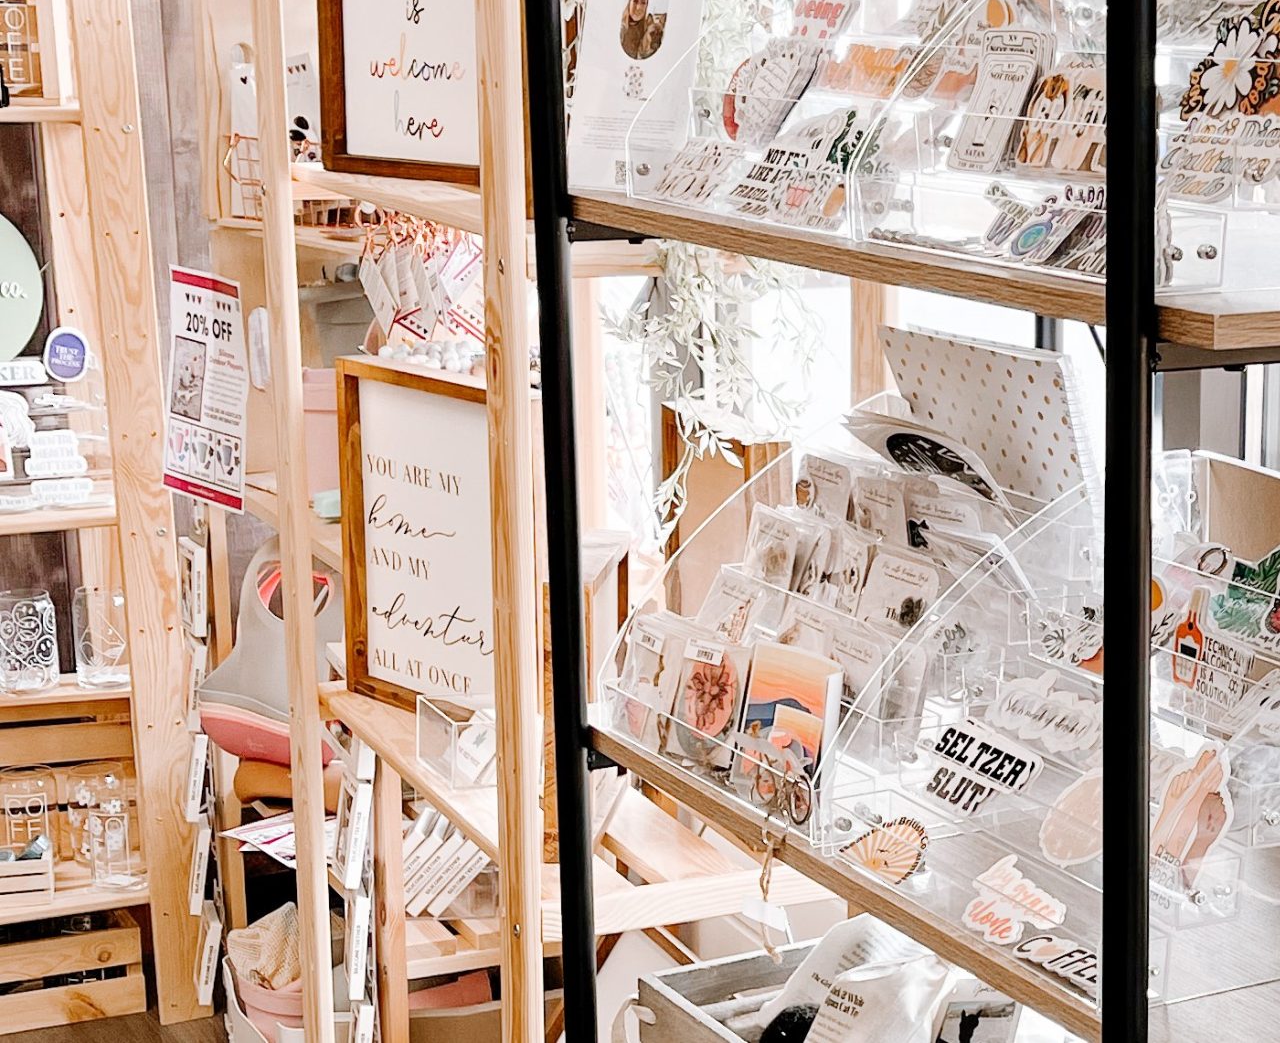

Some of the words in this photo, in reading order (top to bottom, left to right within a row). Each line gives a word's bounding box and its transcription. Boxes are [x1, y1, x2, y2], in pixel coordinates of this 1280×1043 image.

[370, 33, 465, 81] welcome
[394, 90, 444, 140] here
[186, 312, 208, 336] 20%
[212, 318, 232, 342] OFF
[367, 454, 397, 480] YOU
[403, 465, 432, 489] ARE
[439, 472, 461, 496] MY
[368, 494, 456, 538] home
[370, 547, 401, 570] AND
[408, 556, 430, 580] MY
[372, 593, 494, 656] adventur
[373, 648, 399, 672] ALL
[405, 658, 423, 679] AT
[935, 728, 1027, 787] SELTZER
